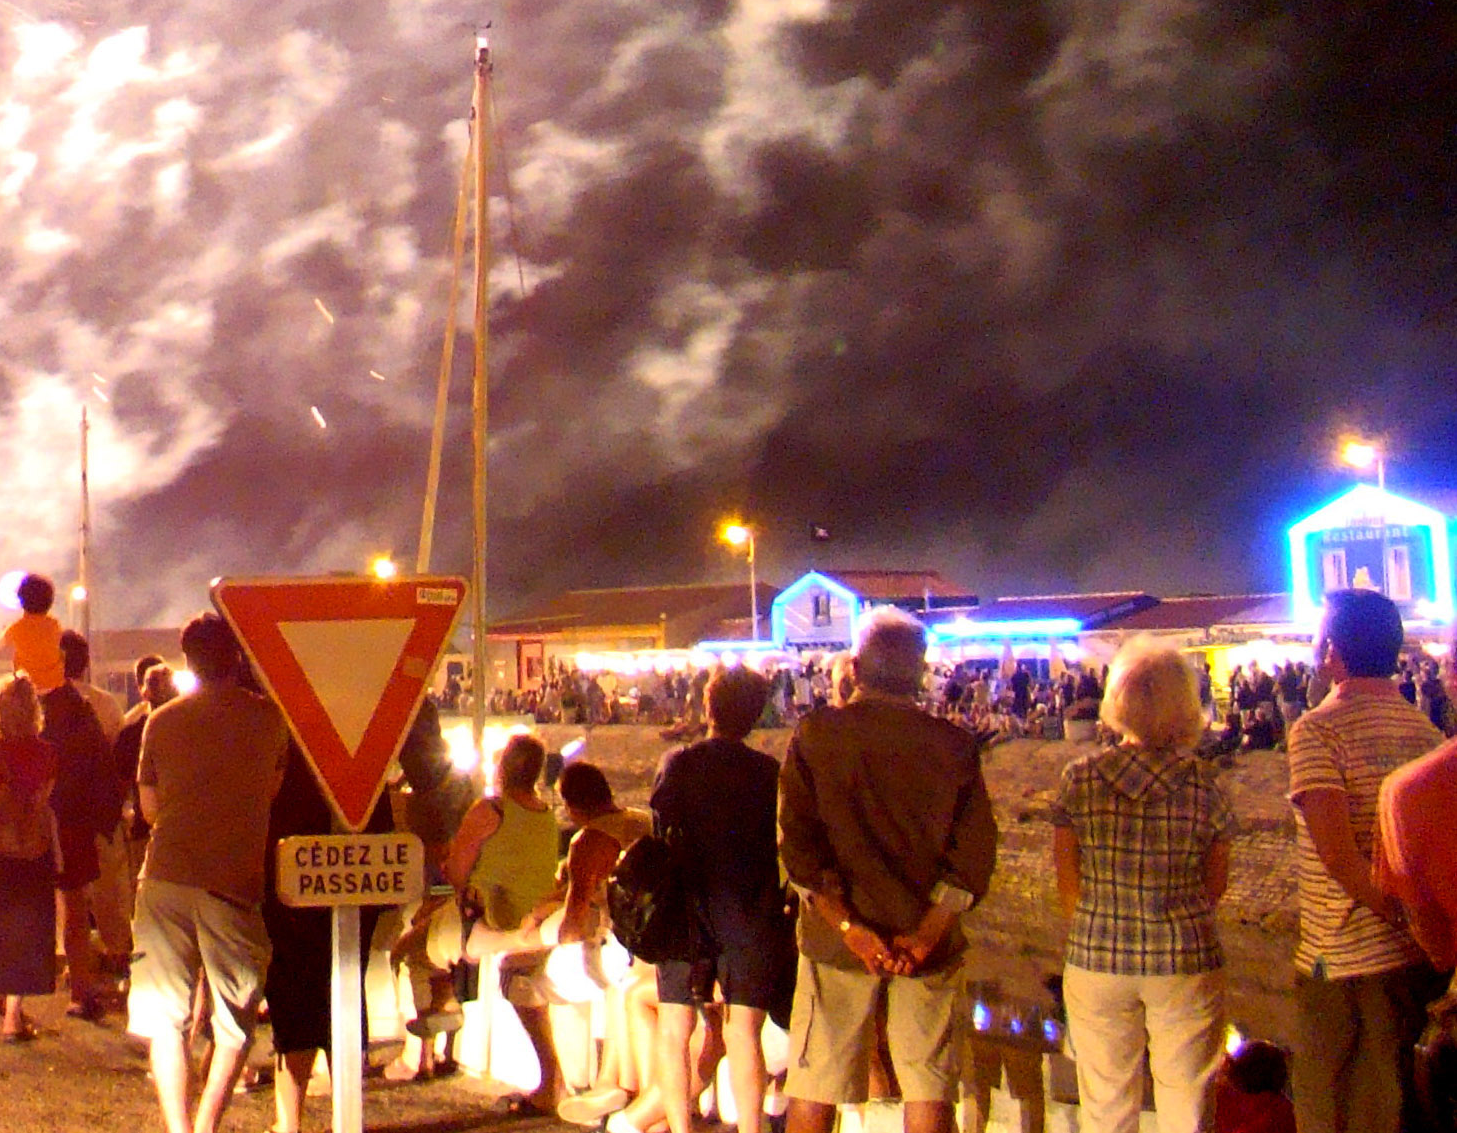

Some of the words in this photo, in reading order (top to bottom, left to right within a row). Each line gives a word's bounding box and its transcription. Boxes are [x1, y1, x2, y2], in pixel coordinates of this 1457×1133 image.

[295, 842, 371, 867] CÉDEZ
[383, 843, 409, 865] LE
[299, 871, 406, 894] PASSAGE
